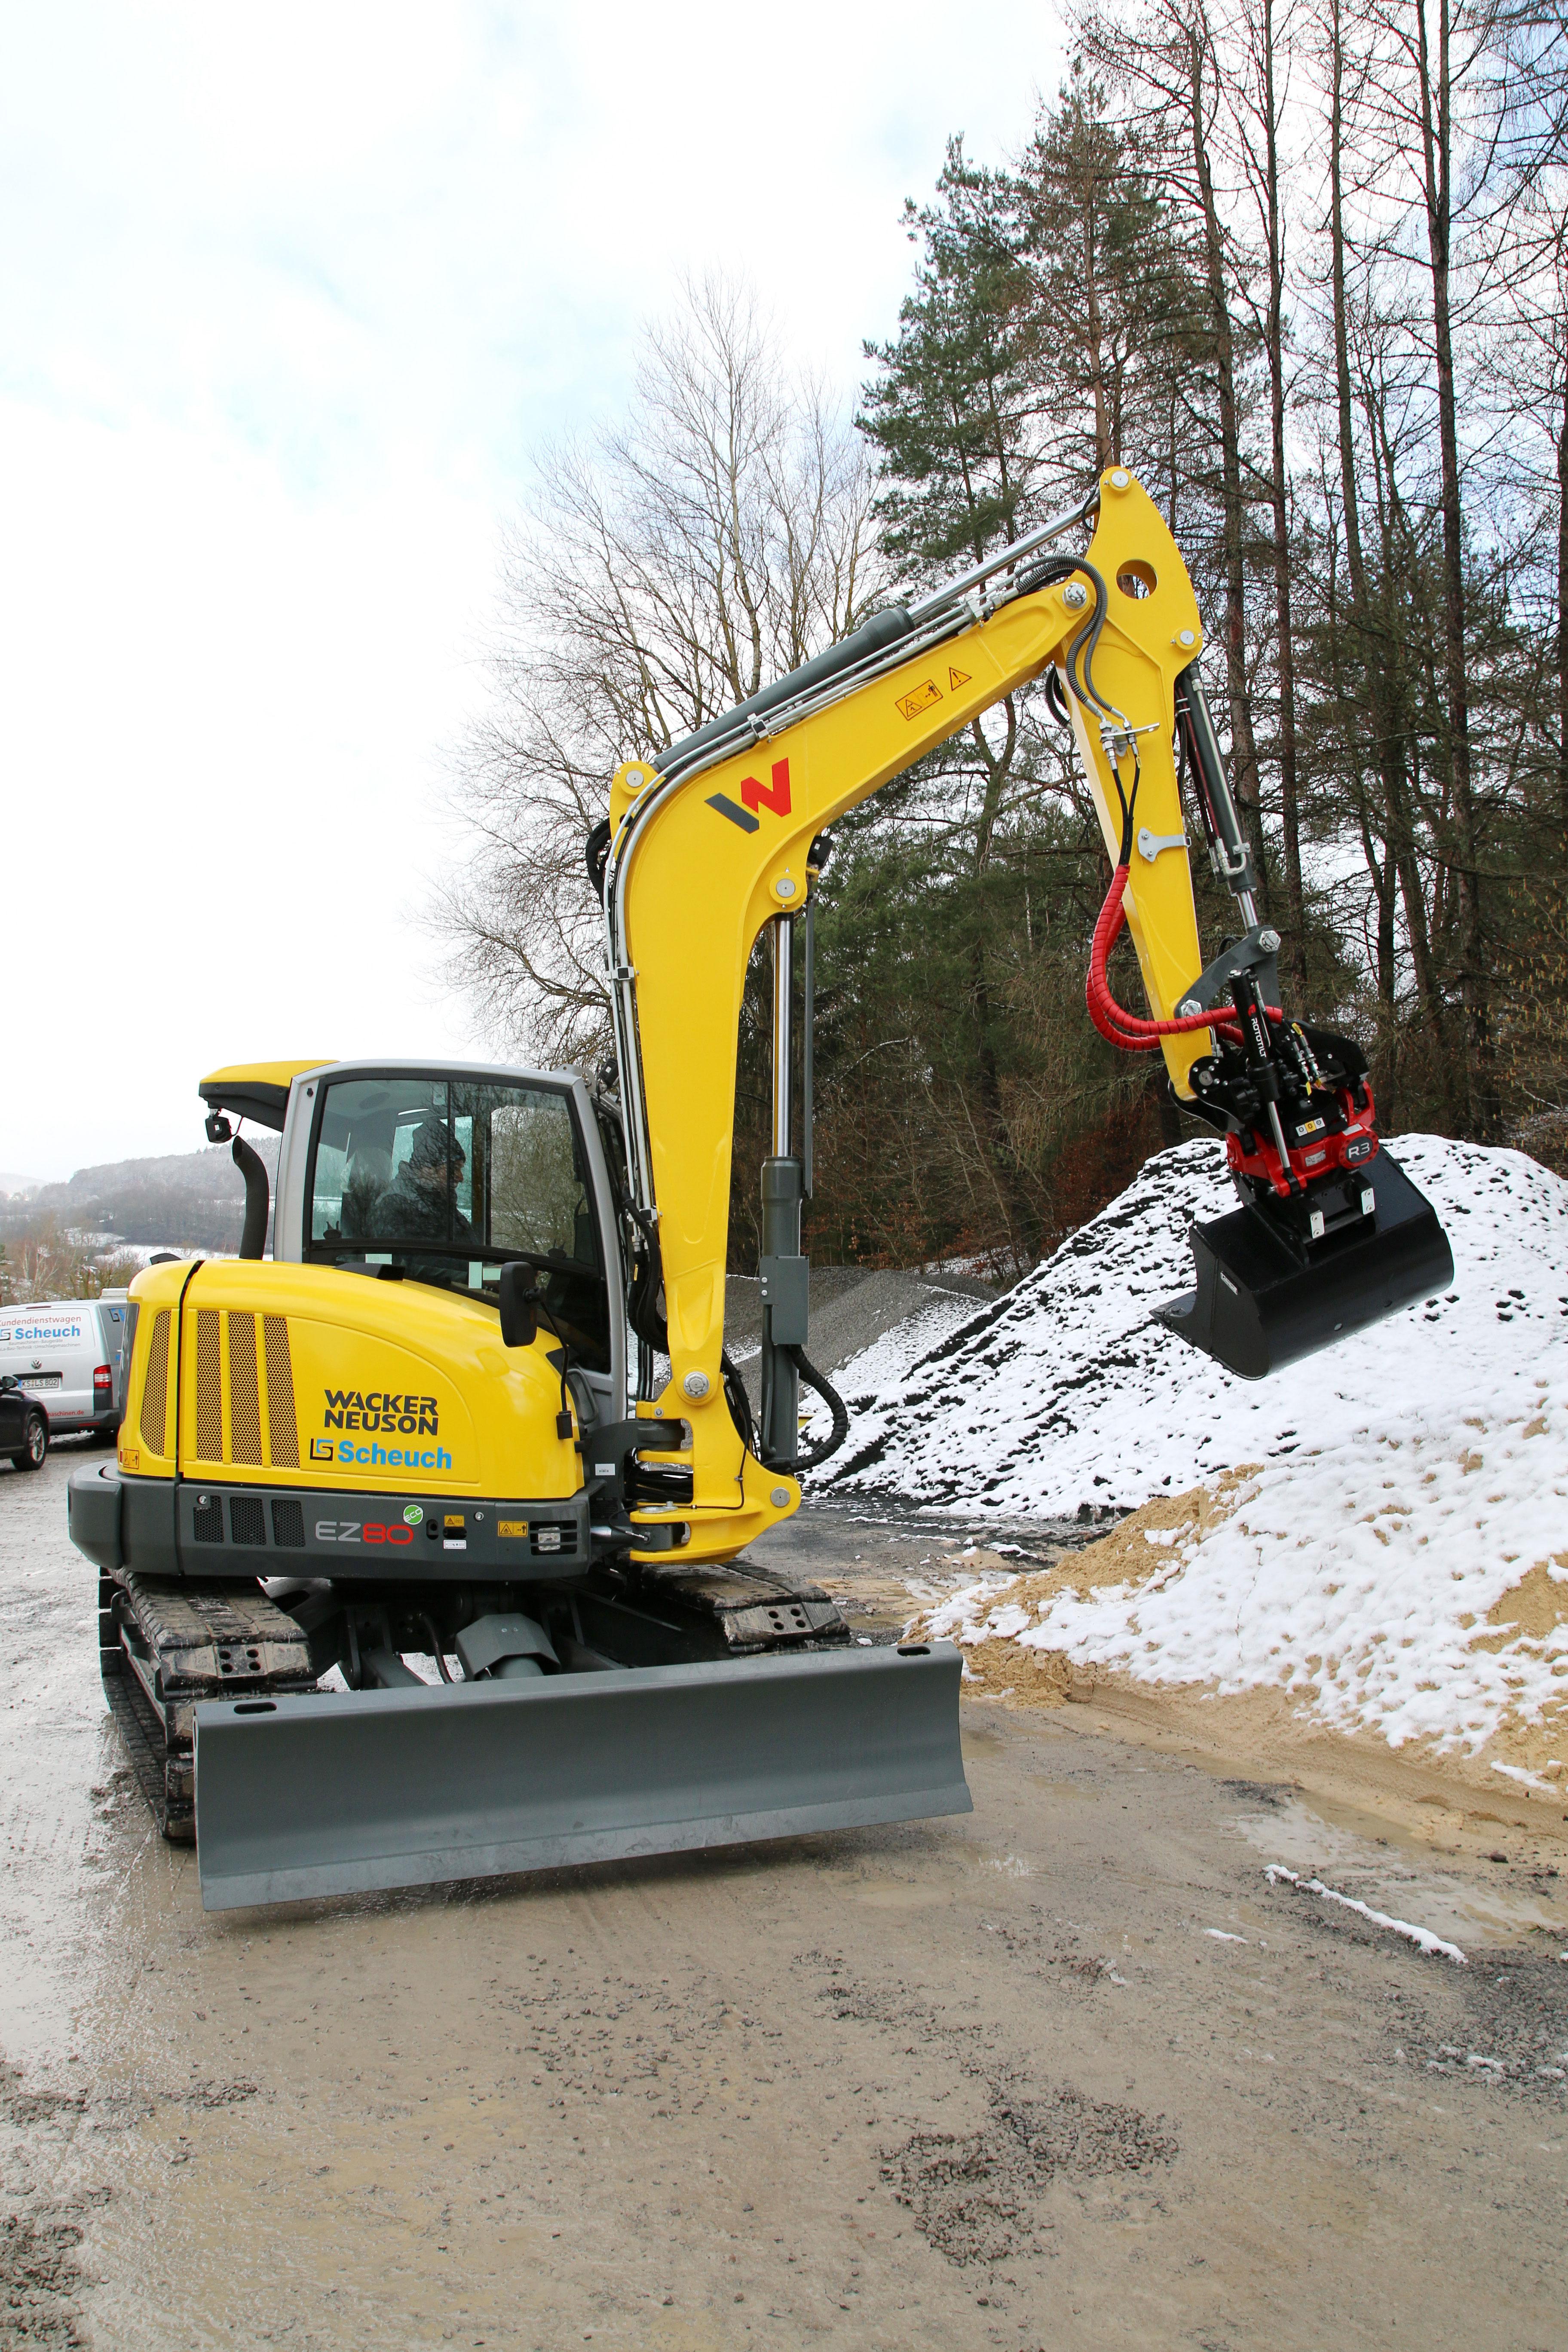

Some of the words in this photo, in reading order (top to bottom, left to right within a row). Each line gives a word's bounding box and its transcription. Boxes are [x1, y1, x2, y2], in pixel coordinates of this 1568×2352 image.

[1251, 1017, 1267, 1057] ROTOTILT
[1348, 1142, 1370, 1159] R3
[15, 1325, 80, 1340] Scheuch
[324, 1389, 439, 1416] WACKER
[324, 1409, 439, 1436] NEUSON
[338, 1440, 452, 1469] Scheuch
[404, 1507, 423, 1522] ECO
[315, 1520, 414, 1545] EZ80
